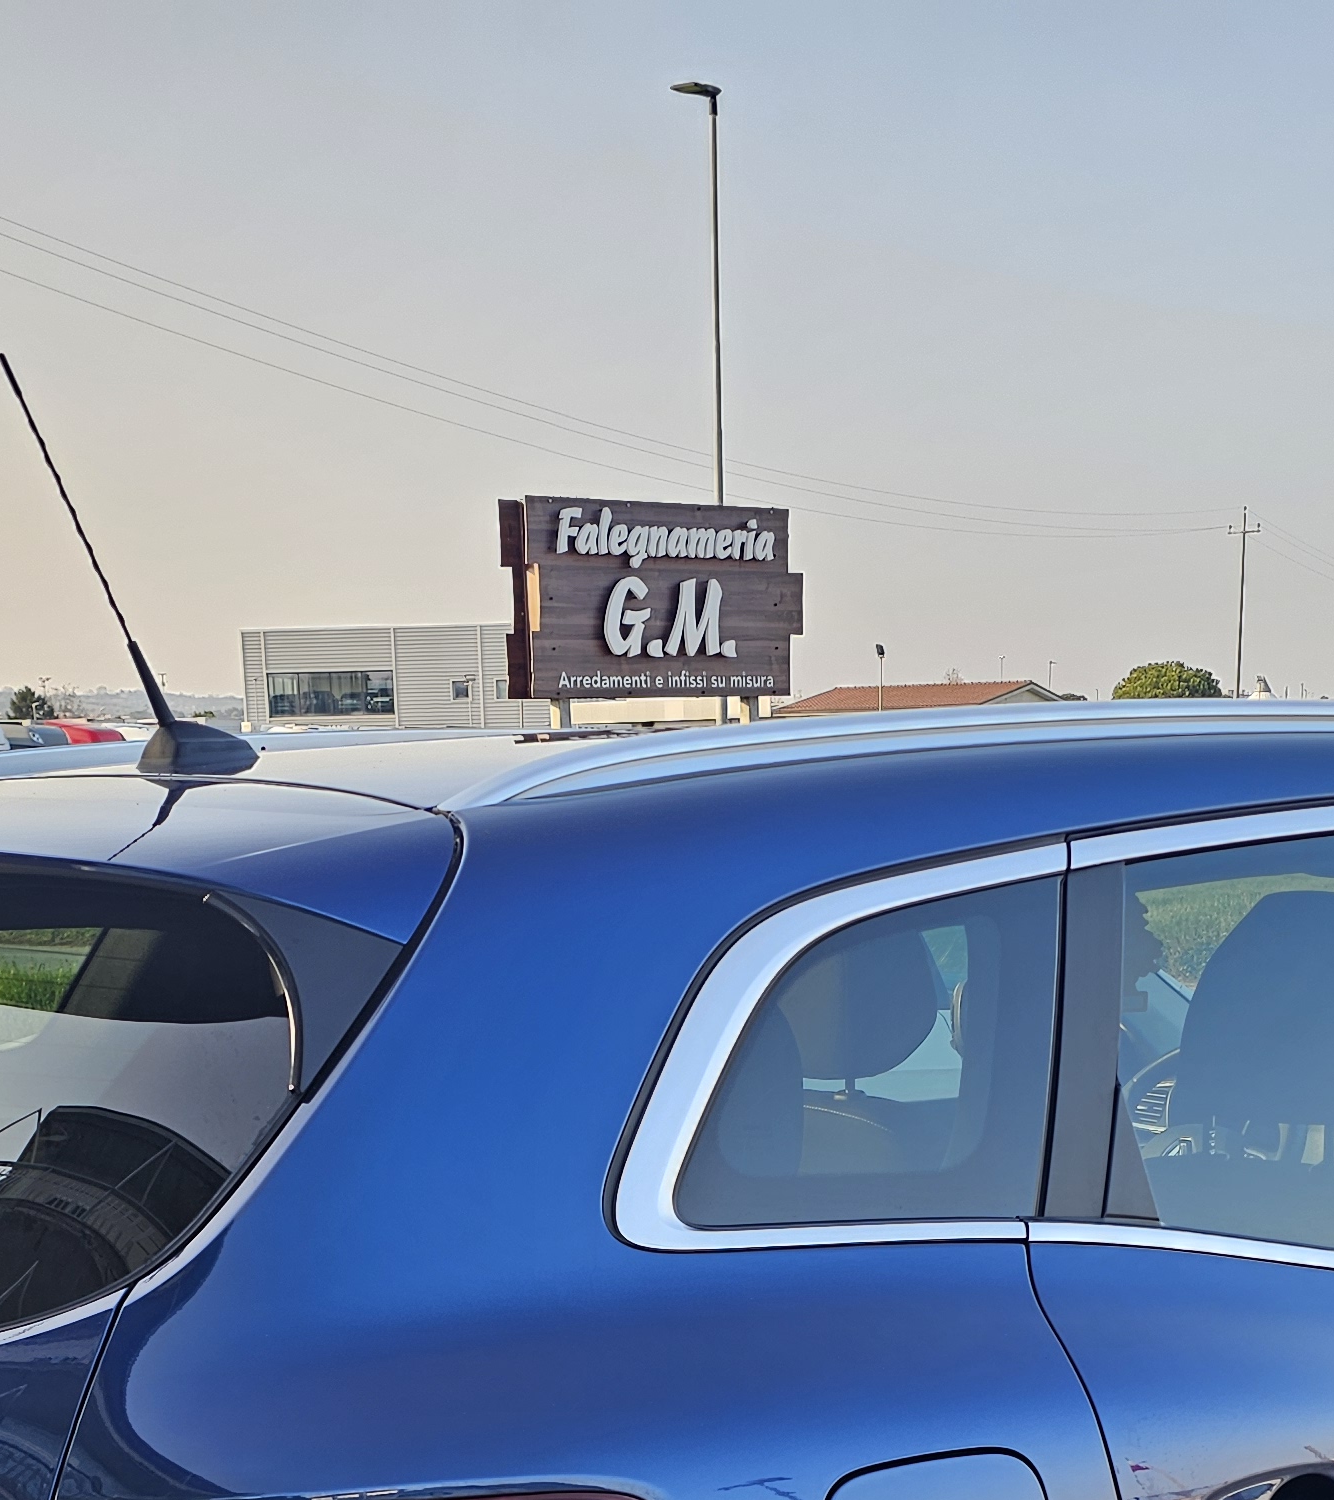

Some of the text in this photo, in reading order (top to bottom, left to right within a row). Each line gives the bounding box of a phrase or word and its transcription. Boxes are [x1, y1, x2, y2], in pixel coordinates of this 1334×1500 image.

[556, 507, 776, 568] Falegnameria
[604, 576, 737, 658] G.M.
[559, 671, 774, 689] Arredamenti e infissi su misura
